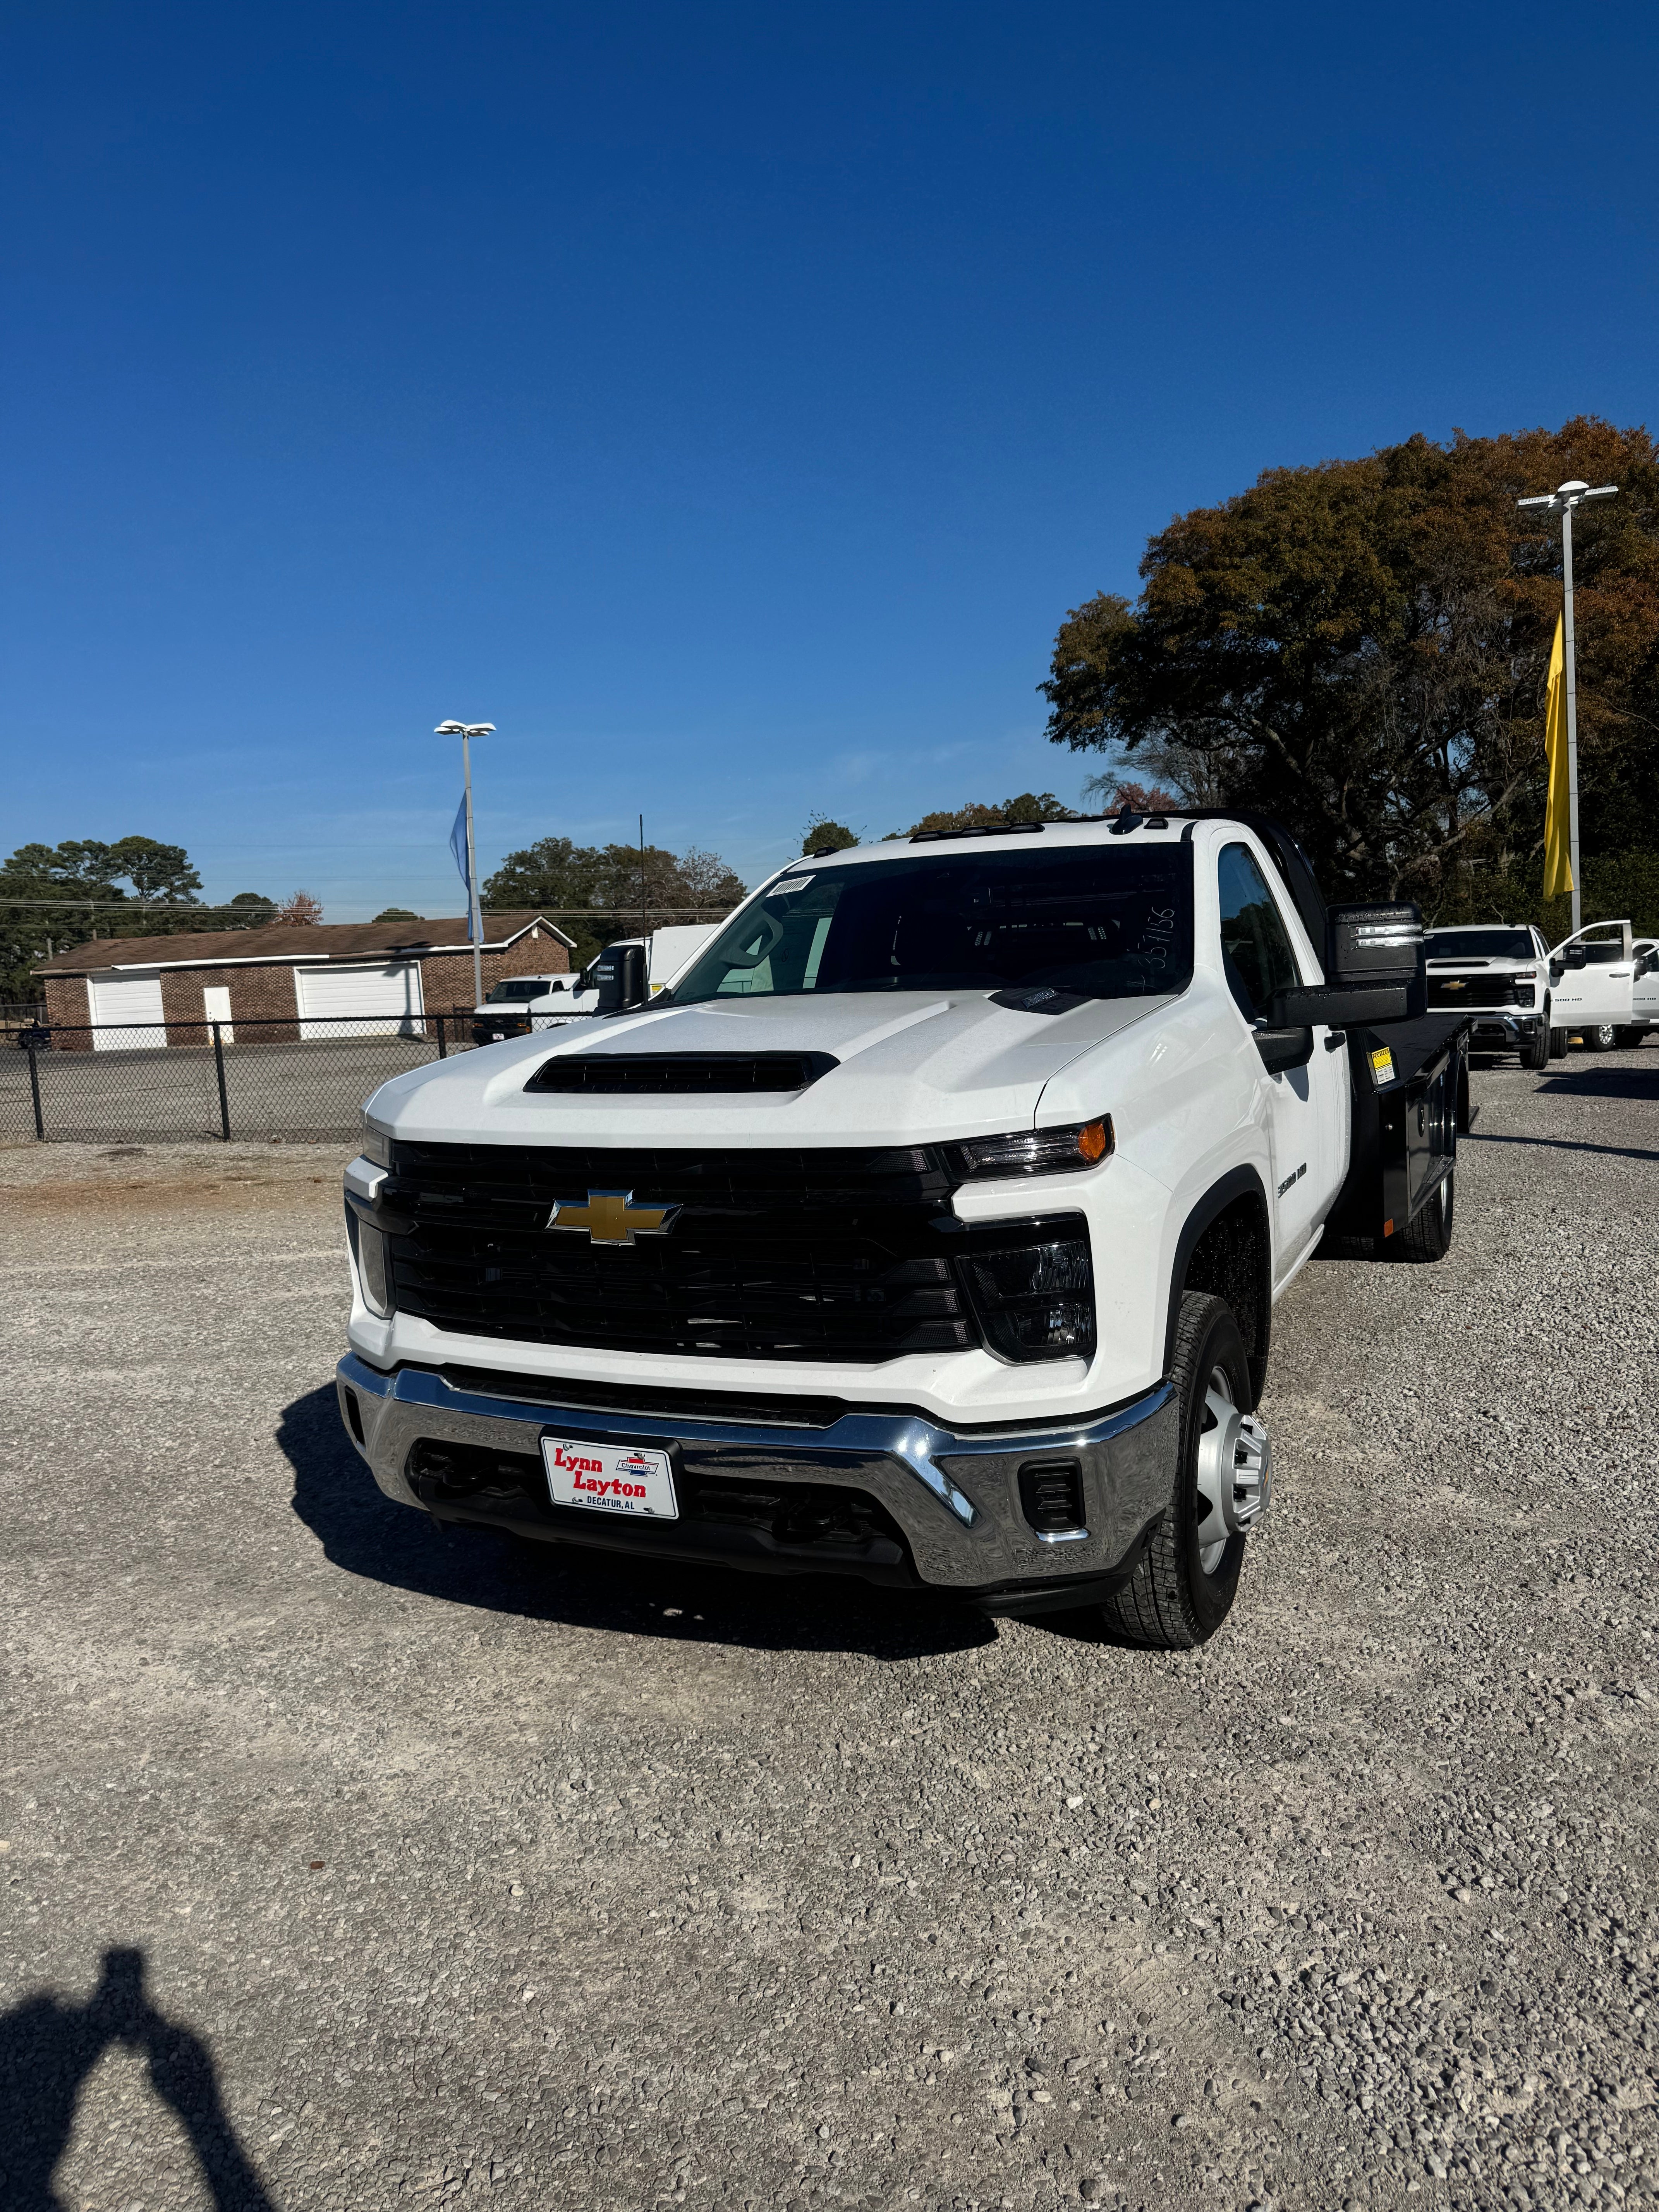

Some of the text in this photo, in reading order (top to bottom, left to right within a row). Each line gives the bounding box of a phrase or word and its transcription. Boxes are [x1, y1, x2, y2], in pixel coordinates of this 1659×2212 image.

[554, 1448, 603, 1472] Lynn
[621, 1463, 651, 1471] Chevrolet
[573, 1470, 646, 1498] Layton
